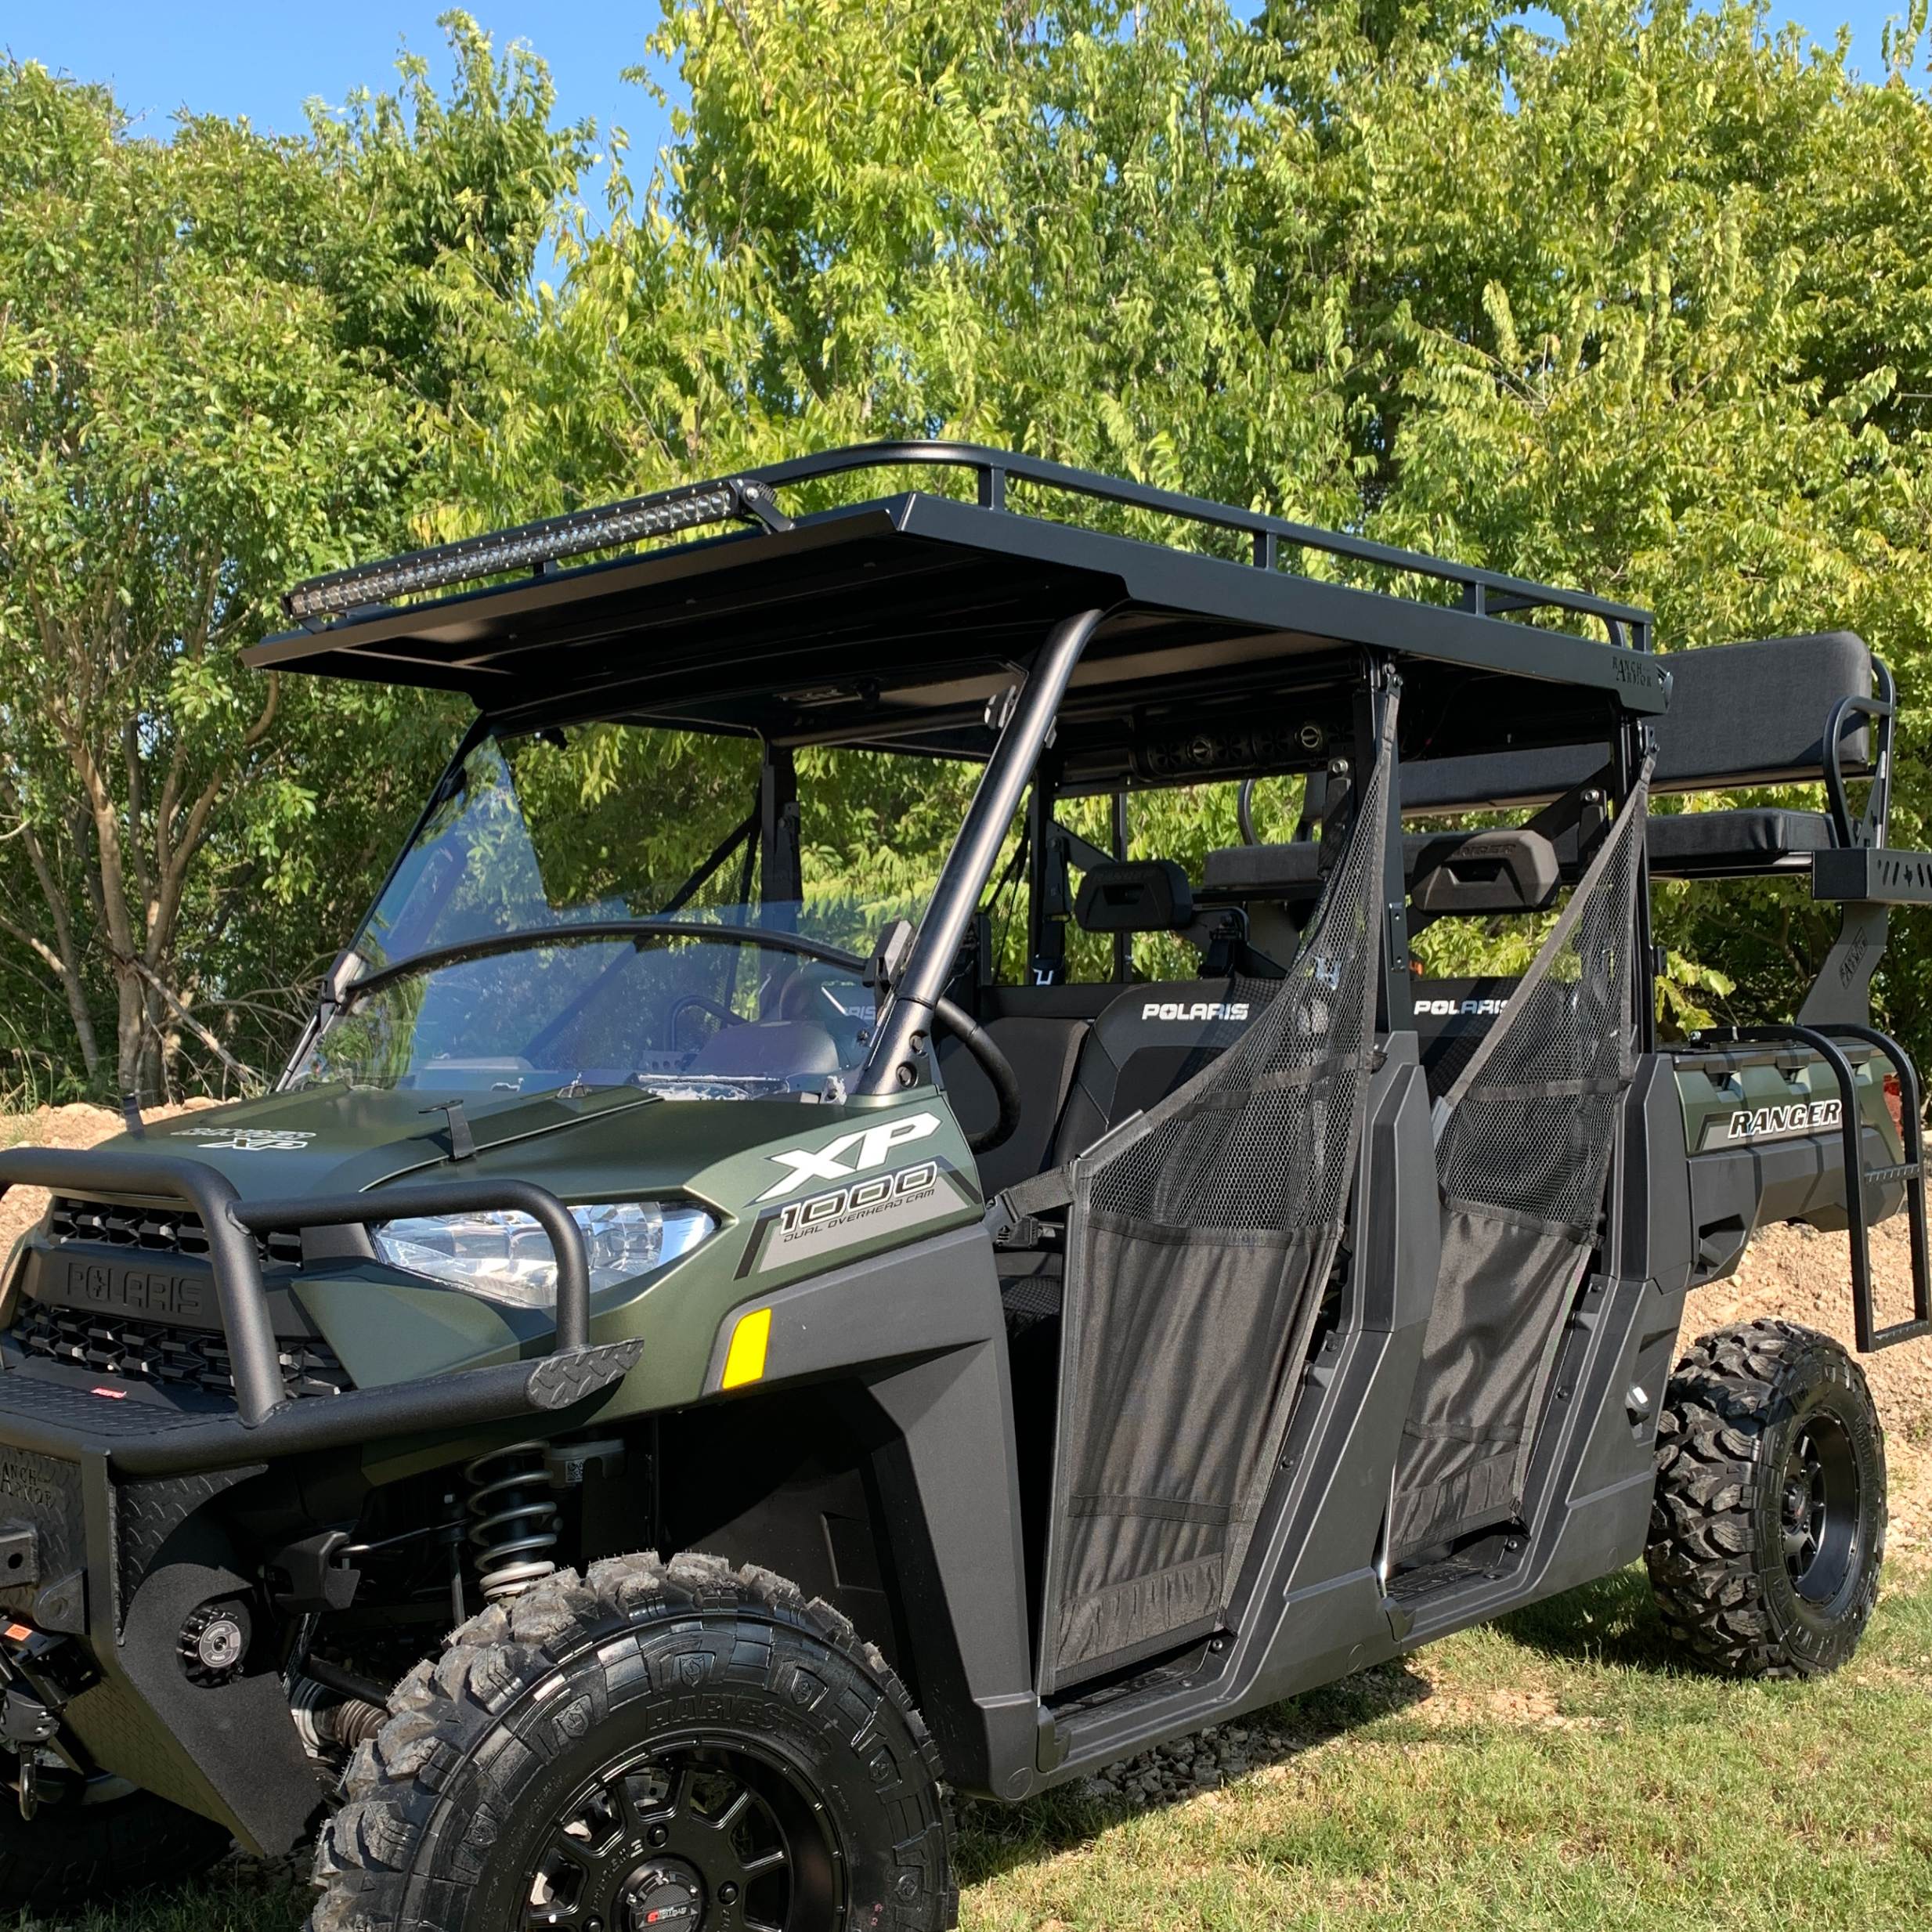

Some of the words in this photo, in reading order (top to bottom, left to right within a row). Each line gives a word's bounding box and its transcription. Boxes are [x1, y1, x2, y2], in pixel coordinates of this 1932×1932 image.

[1141, 1002, 1249, 1020] POLARIS
[1728, 1100, 1842, 1139] RANGER
[753, 1111, 942, 1203] XP
[780, 1161, 937, 1235] 1000
[783, 1226, 823, 1243] DUAL
[828, 1199, 903, 1229] OVERHEAD
[905, 1188, 935, 1203] CAM
[67, 1262, 204, 1316] POLARIS
